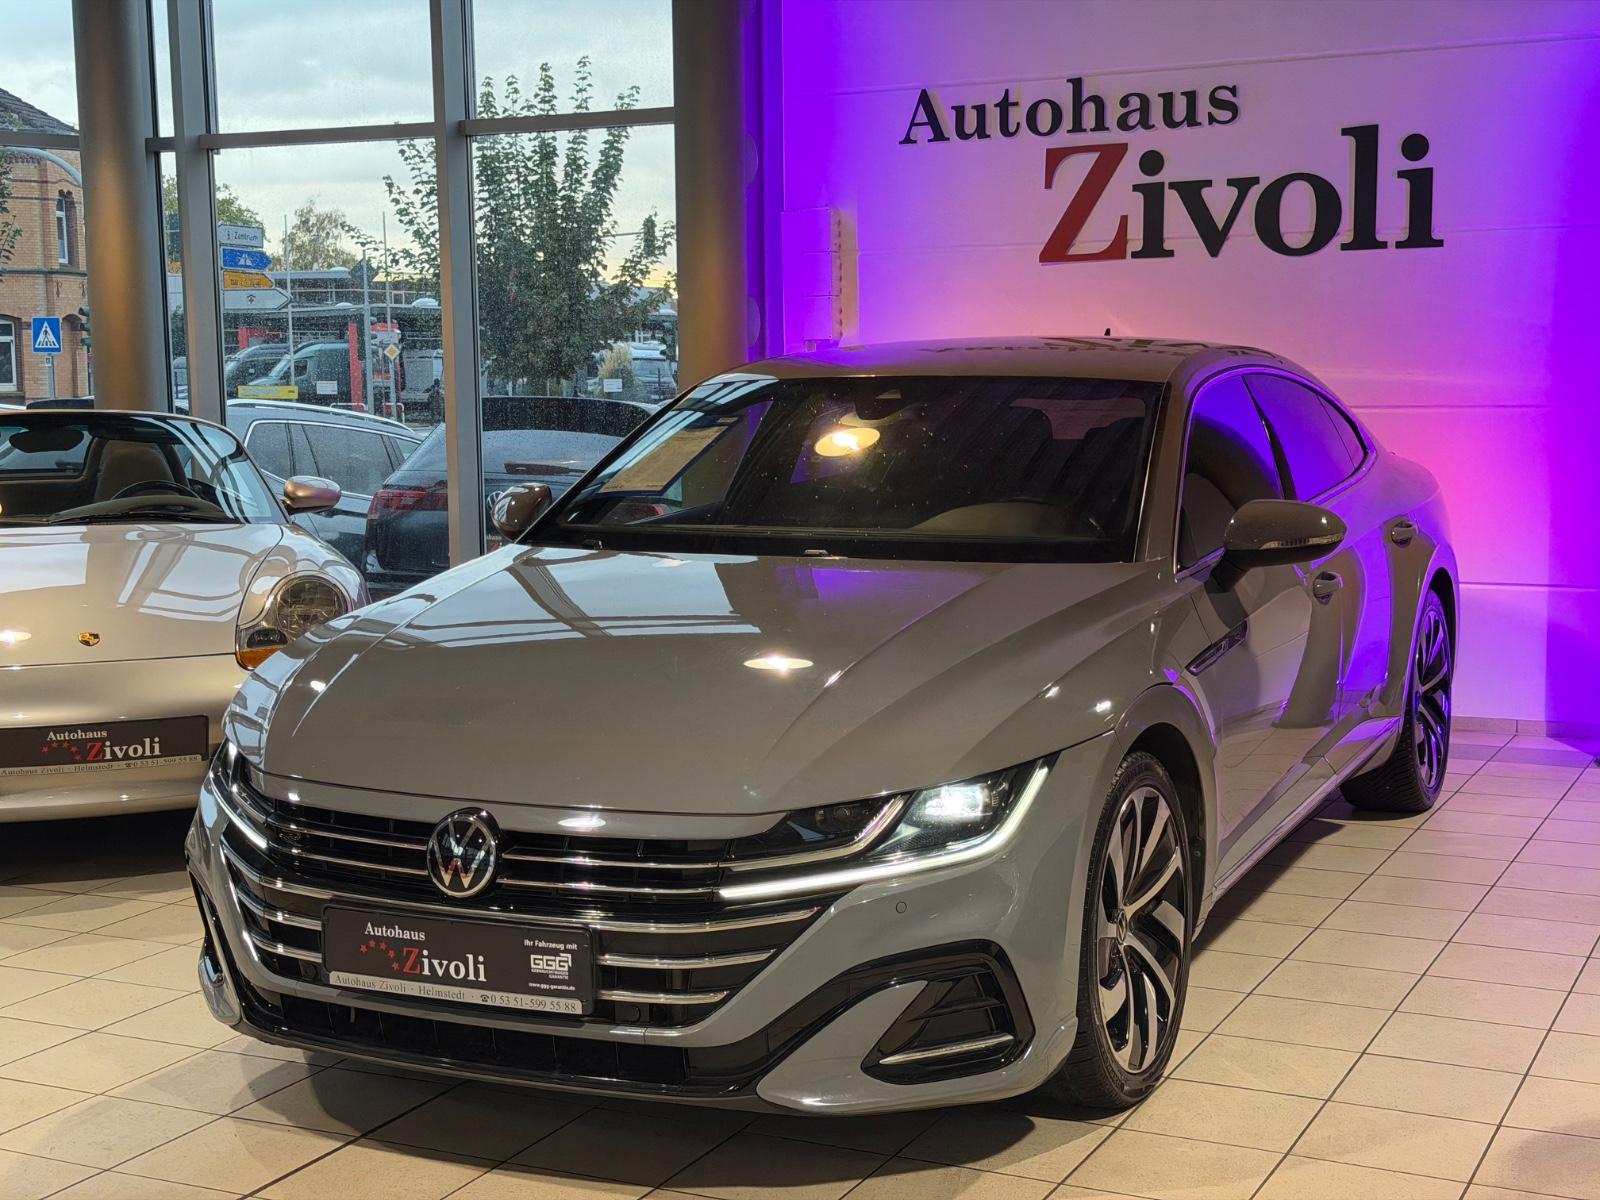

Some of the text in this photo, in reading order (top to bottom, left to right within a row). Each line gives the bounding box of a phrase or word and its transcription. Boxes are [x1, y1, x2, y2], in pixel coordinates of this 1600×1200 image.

[899, 77, 1239, 145] Autohaus
[1039, 124, 1444, 265] Zivoli
[234, 231, 259, 241] Zentrum
[47, 730, 108, 742] Autohaus
[87, 737, 161, 761] Zivoli
[1, 767, 38, 776] Autohaus
[364, 921, 426, 941] Autohaus
[524, 939, 578, 951] Ihr Fahrzeug mit
[403, 947, 487, 982] Zivoli
[530, 953, 571, 972] GGG
[335, 975, 577, 1013] Autohaus Zivoli Helmstedt 0 53 51-599 55 88
